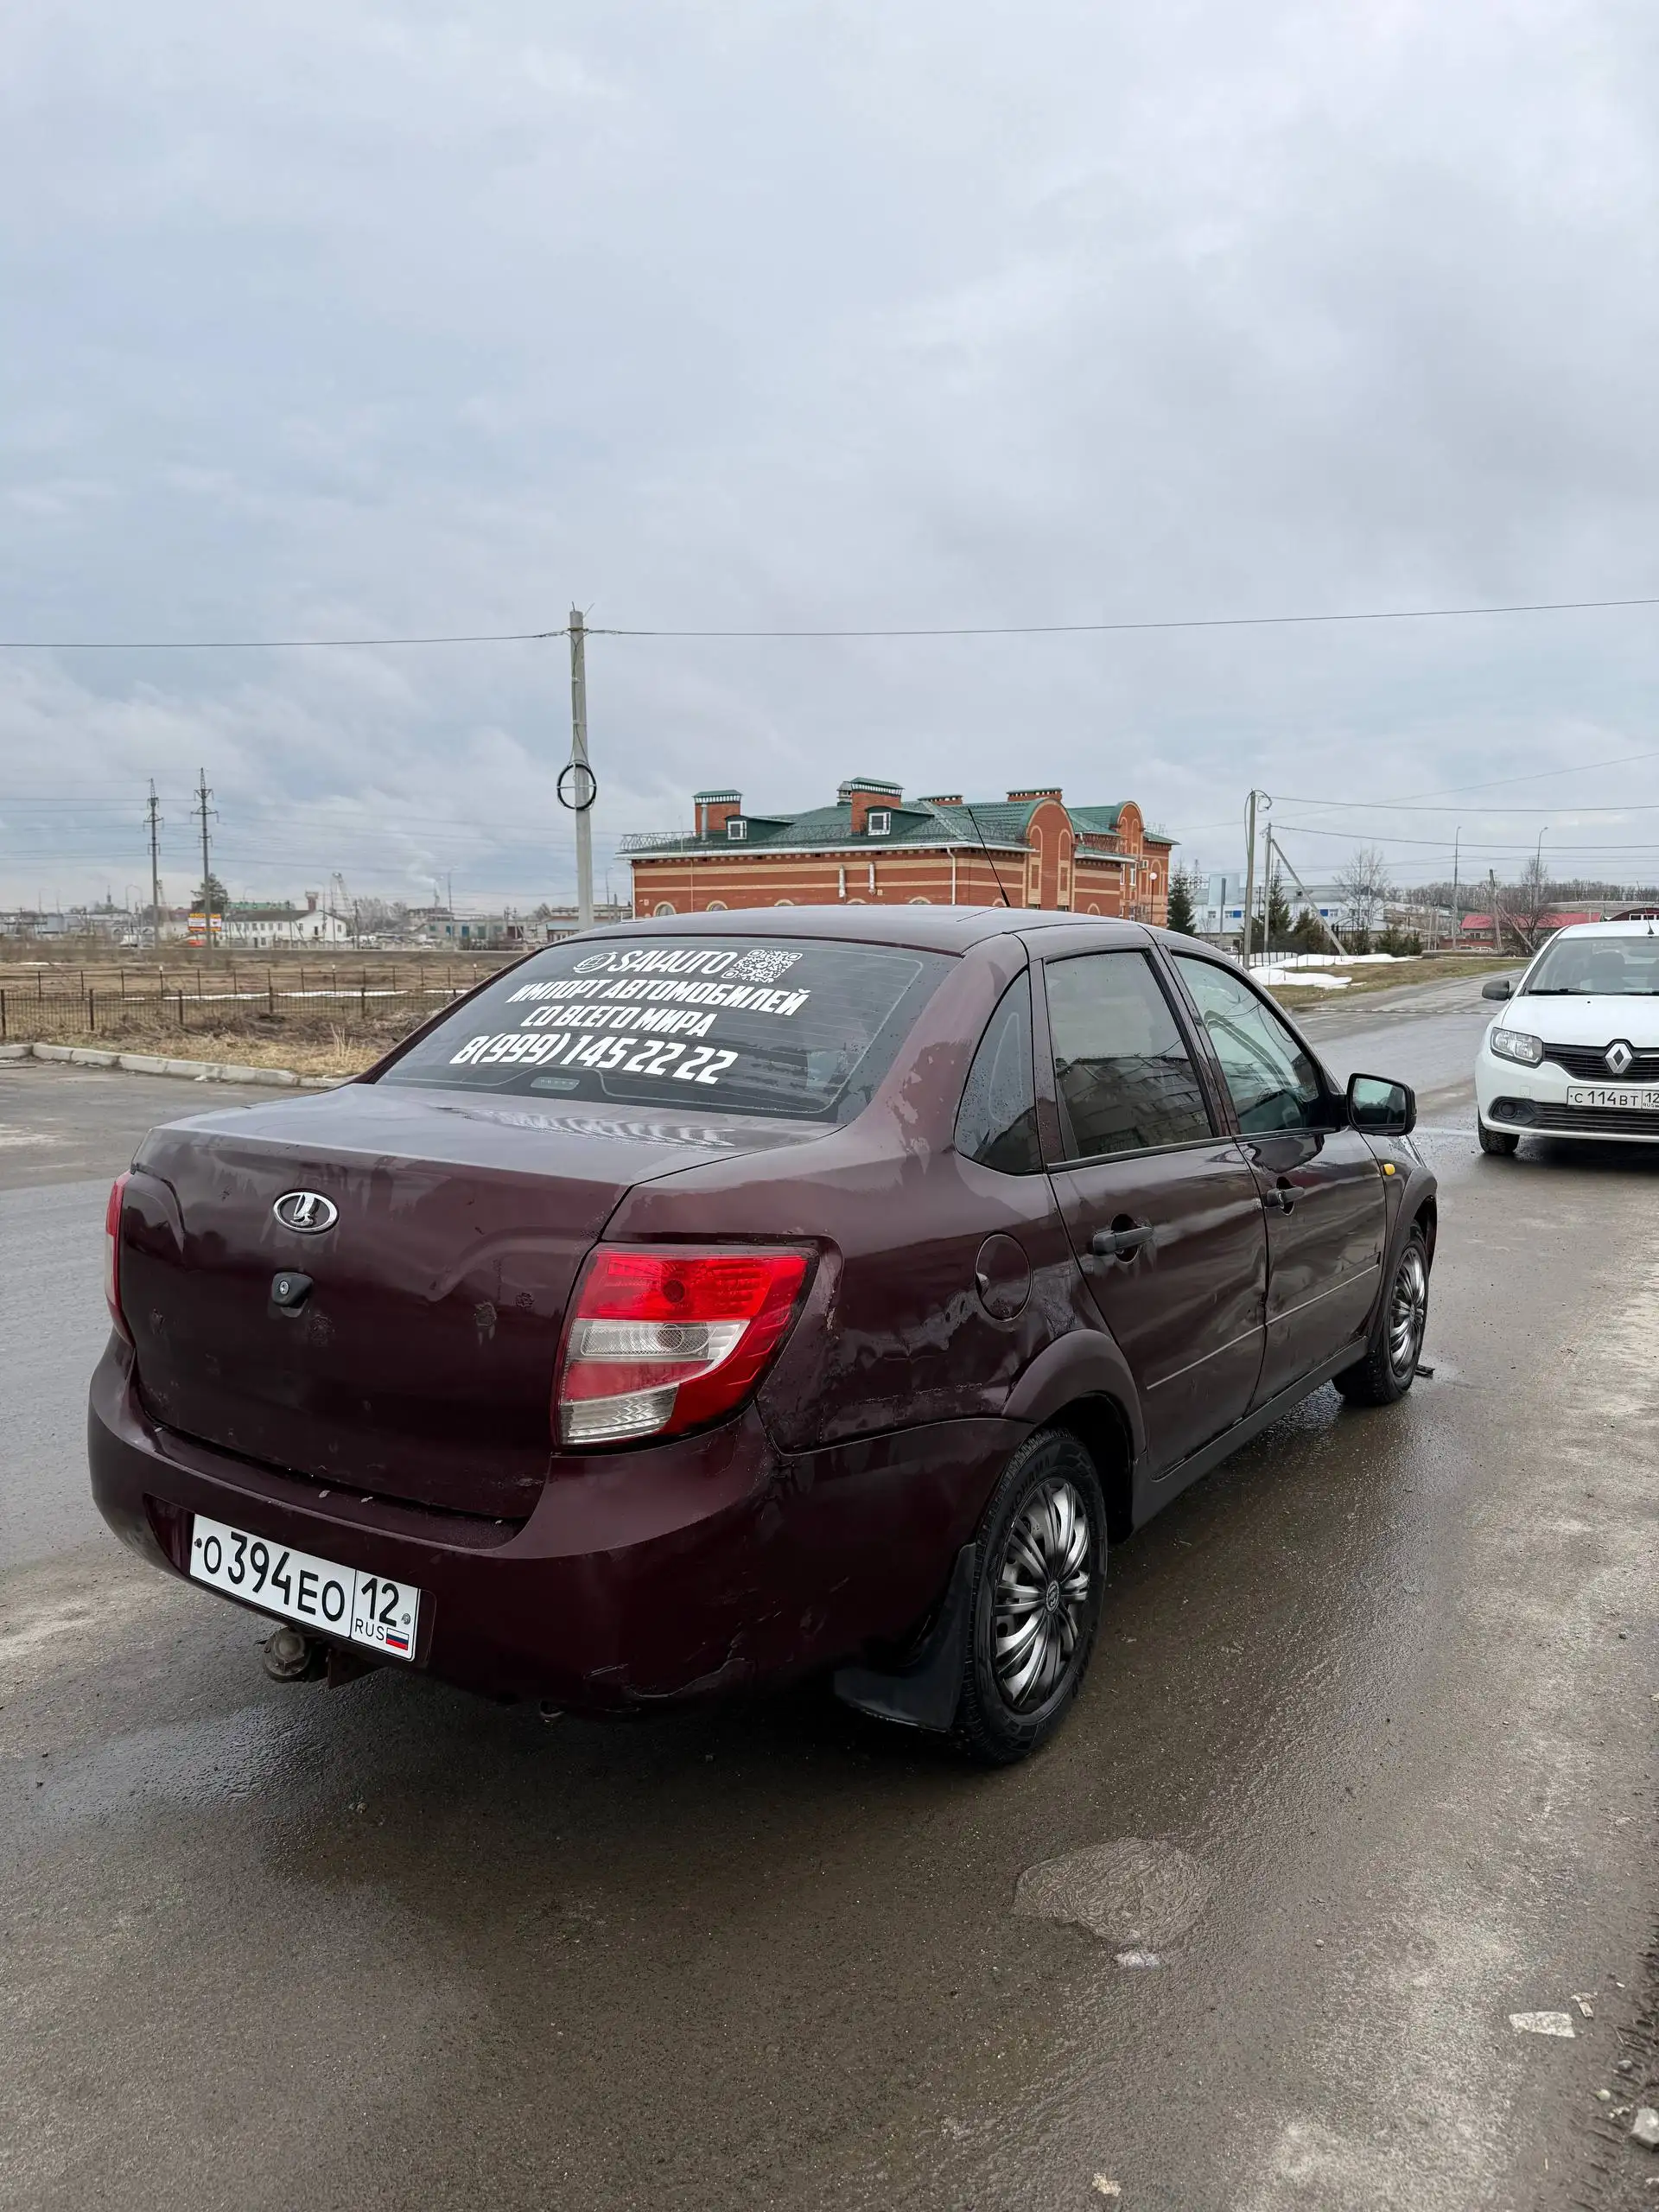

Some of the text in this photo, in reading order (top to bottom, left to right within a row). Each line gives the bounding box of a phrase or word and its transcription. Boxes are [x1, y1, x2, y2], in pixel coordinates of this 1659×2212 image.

[505, 979, 810, 1015] ИМПОРТ АВТОМОБИЛЕЙ
[520, 1006, 717, 1037] СО ВСЕГО МИРА
[449, 1033, 739, 1084] 8(999) 145 22 22
[1574, 1091, 1659, 1106] С114ВТ 12
[203, 1531, 400, 1627] О394ЕО 12
[355, 1618, 385, 1641] RUS
